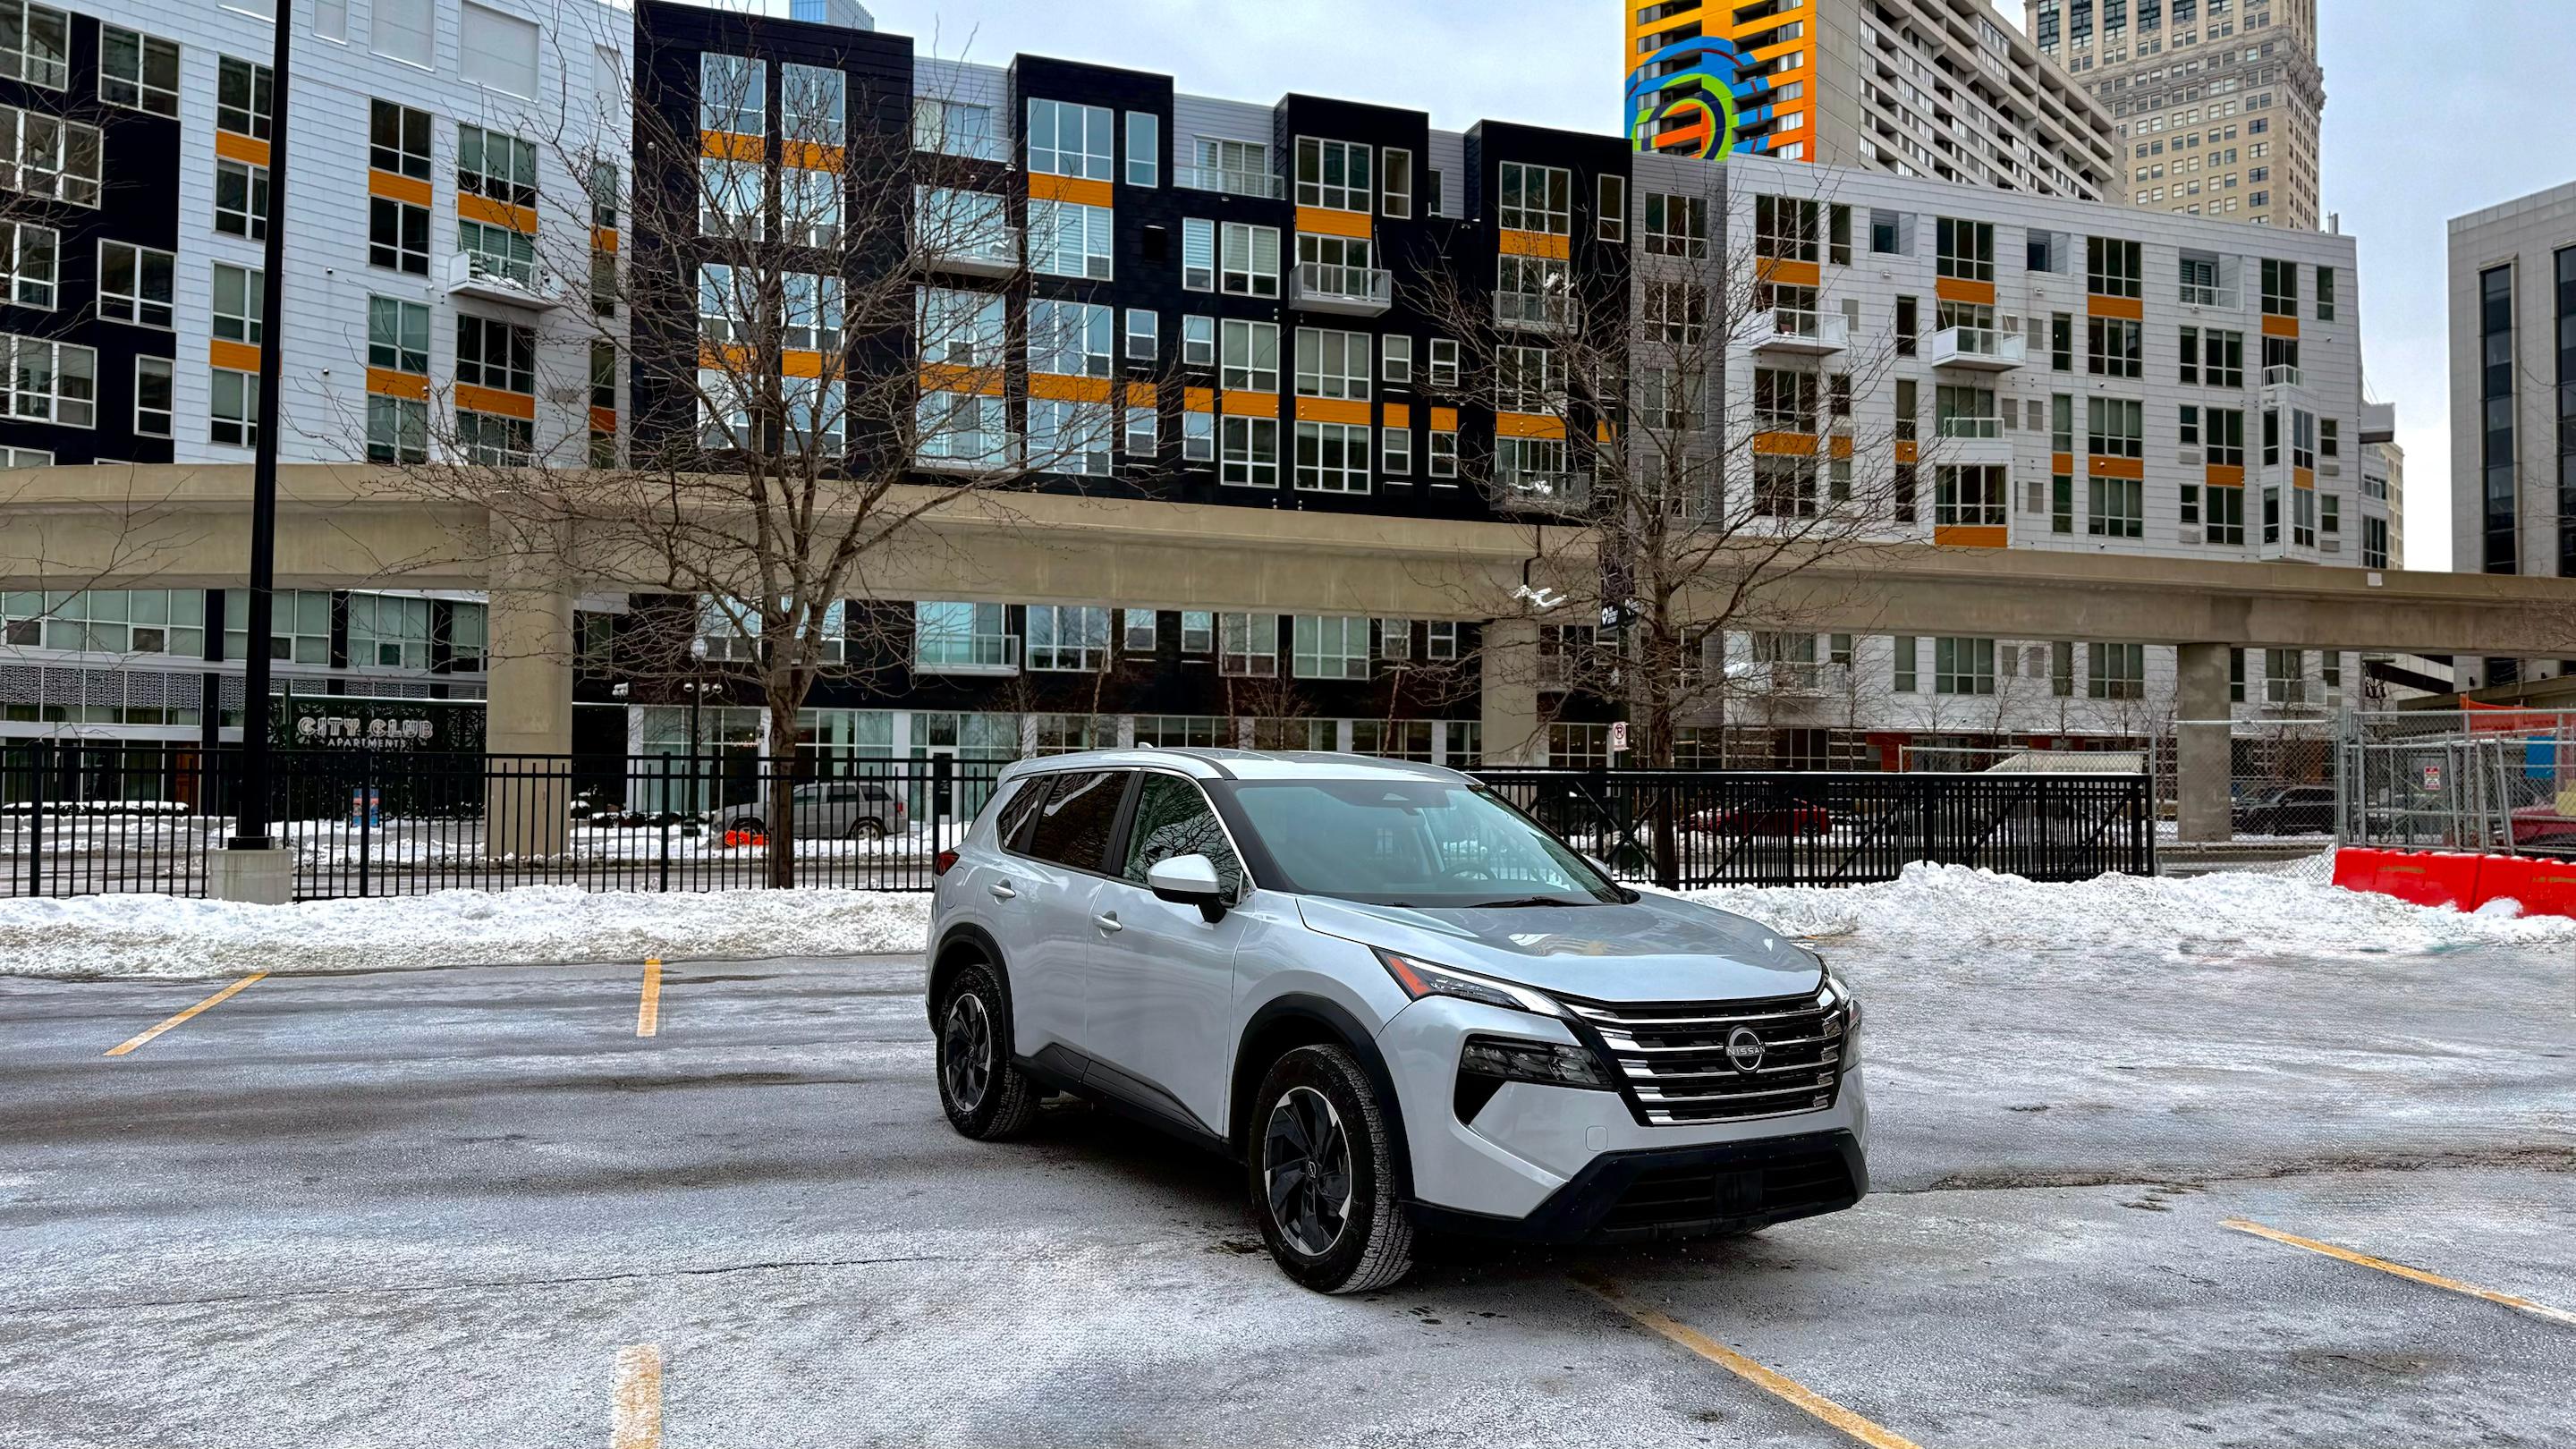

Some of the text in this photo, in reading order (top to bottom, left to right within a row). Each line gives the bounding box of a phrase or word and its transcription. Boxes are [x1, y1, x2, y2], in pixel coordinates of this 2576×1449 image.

[298, 717, 433, 739] CITY CLUB
[327, 738, 406, 748] APARTMENTS
[1727, 1046, 1766, 1055] NISSAN
